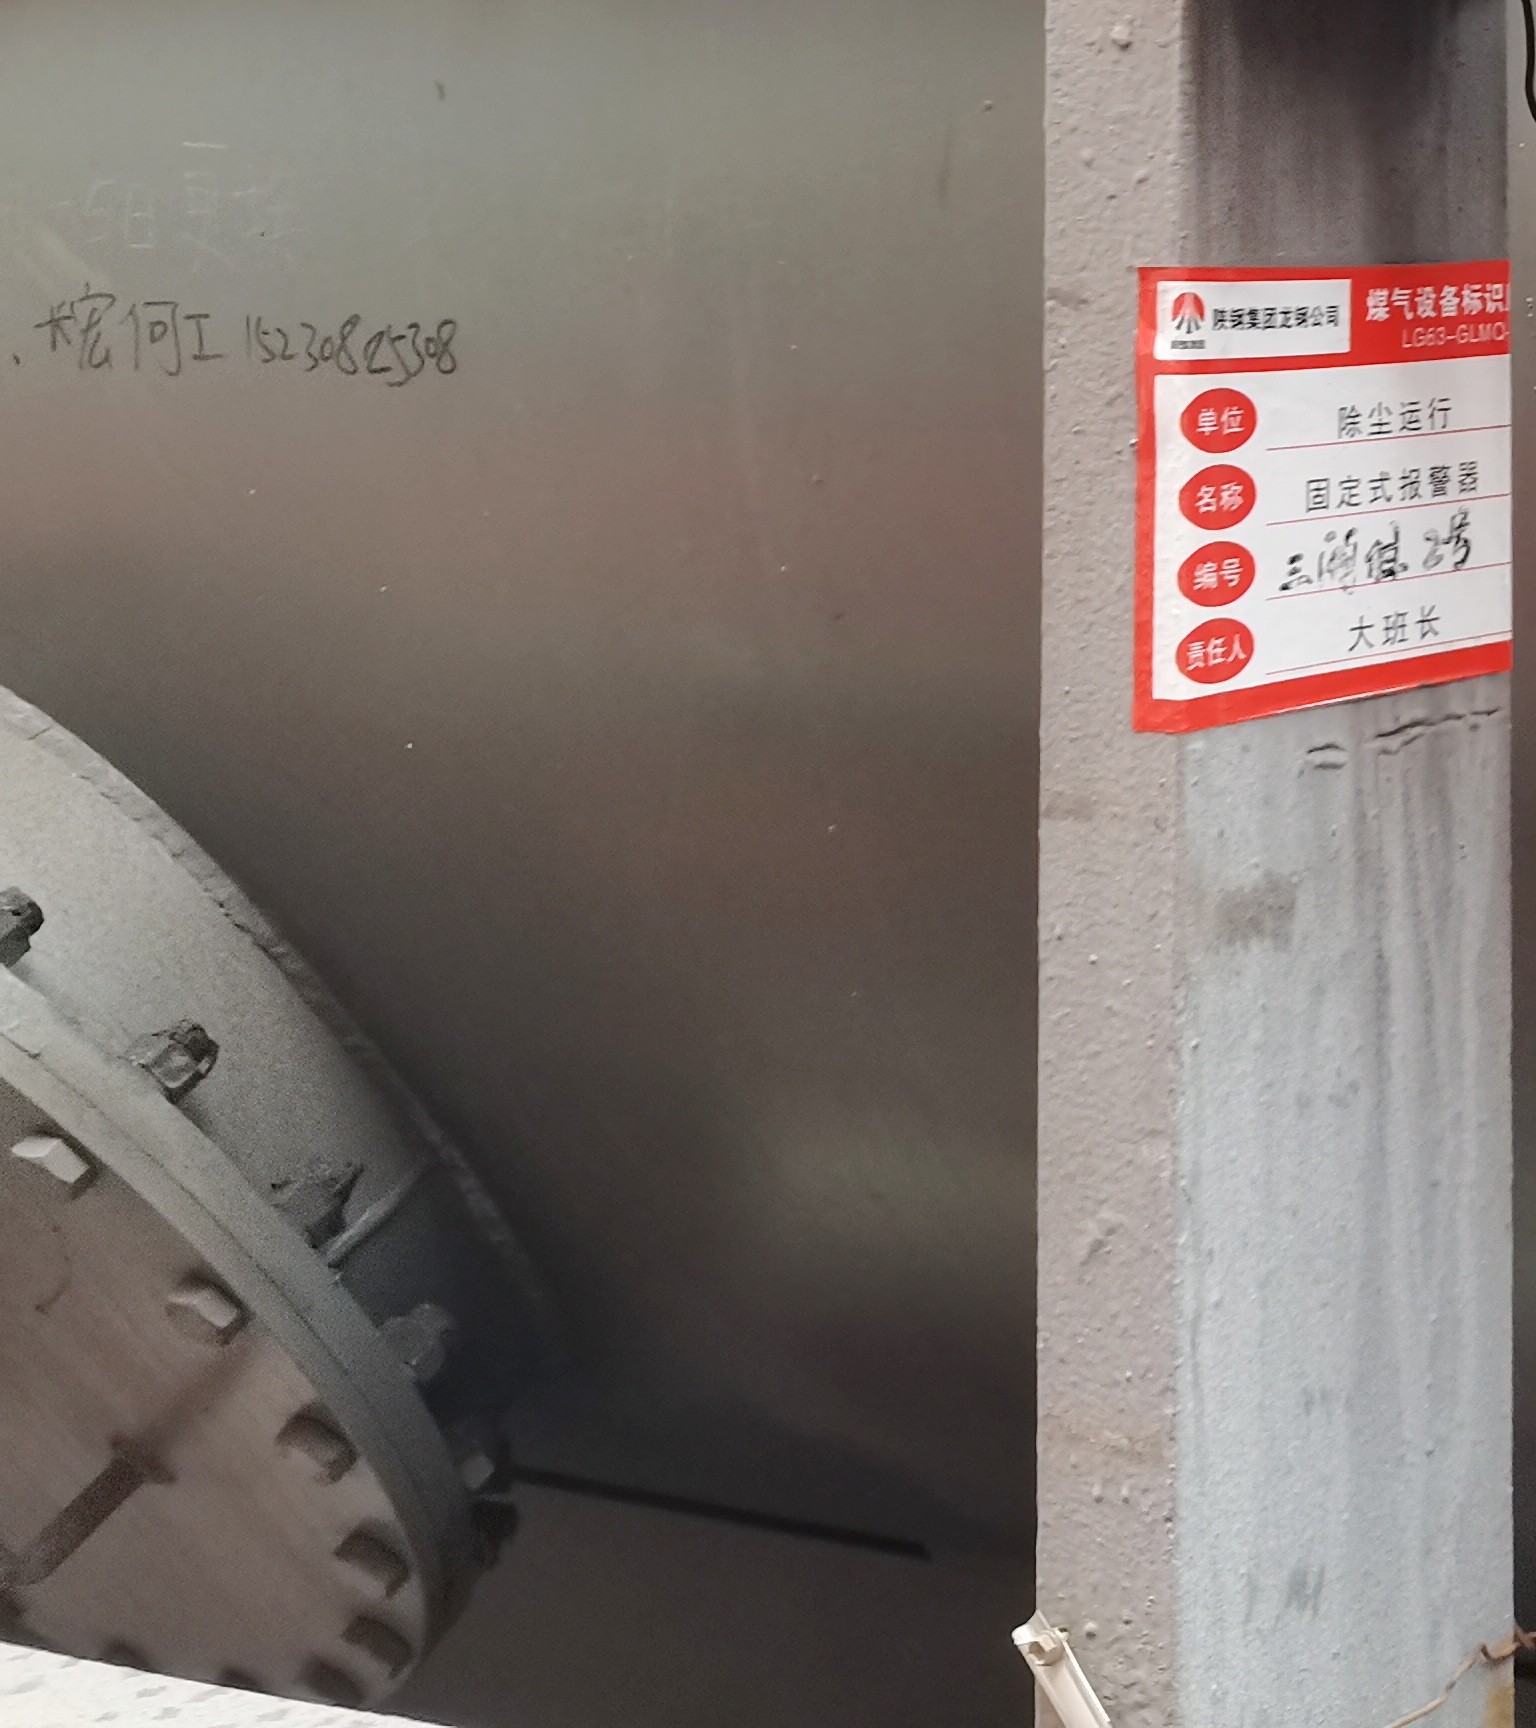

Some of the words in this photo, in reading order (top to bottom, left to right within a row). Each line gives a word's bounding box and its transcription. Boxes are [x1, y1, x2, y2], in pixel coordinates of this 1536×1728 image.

[1365, 283, 1510, 322] 煤气设备标识
[1196, 407, 1245, 437] 单位
[1337, 397, 1453, 440] 除尘运行
[1194, 483, 1244, 514] 名称
[1305, 461, 1480, 514] 固定式报警器
[1193, 558, 1244, 590] 编号
[1347, 604, 1442, 653] 大班长
[1185, 639, 1247, 672] 责任人
